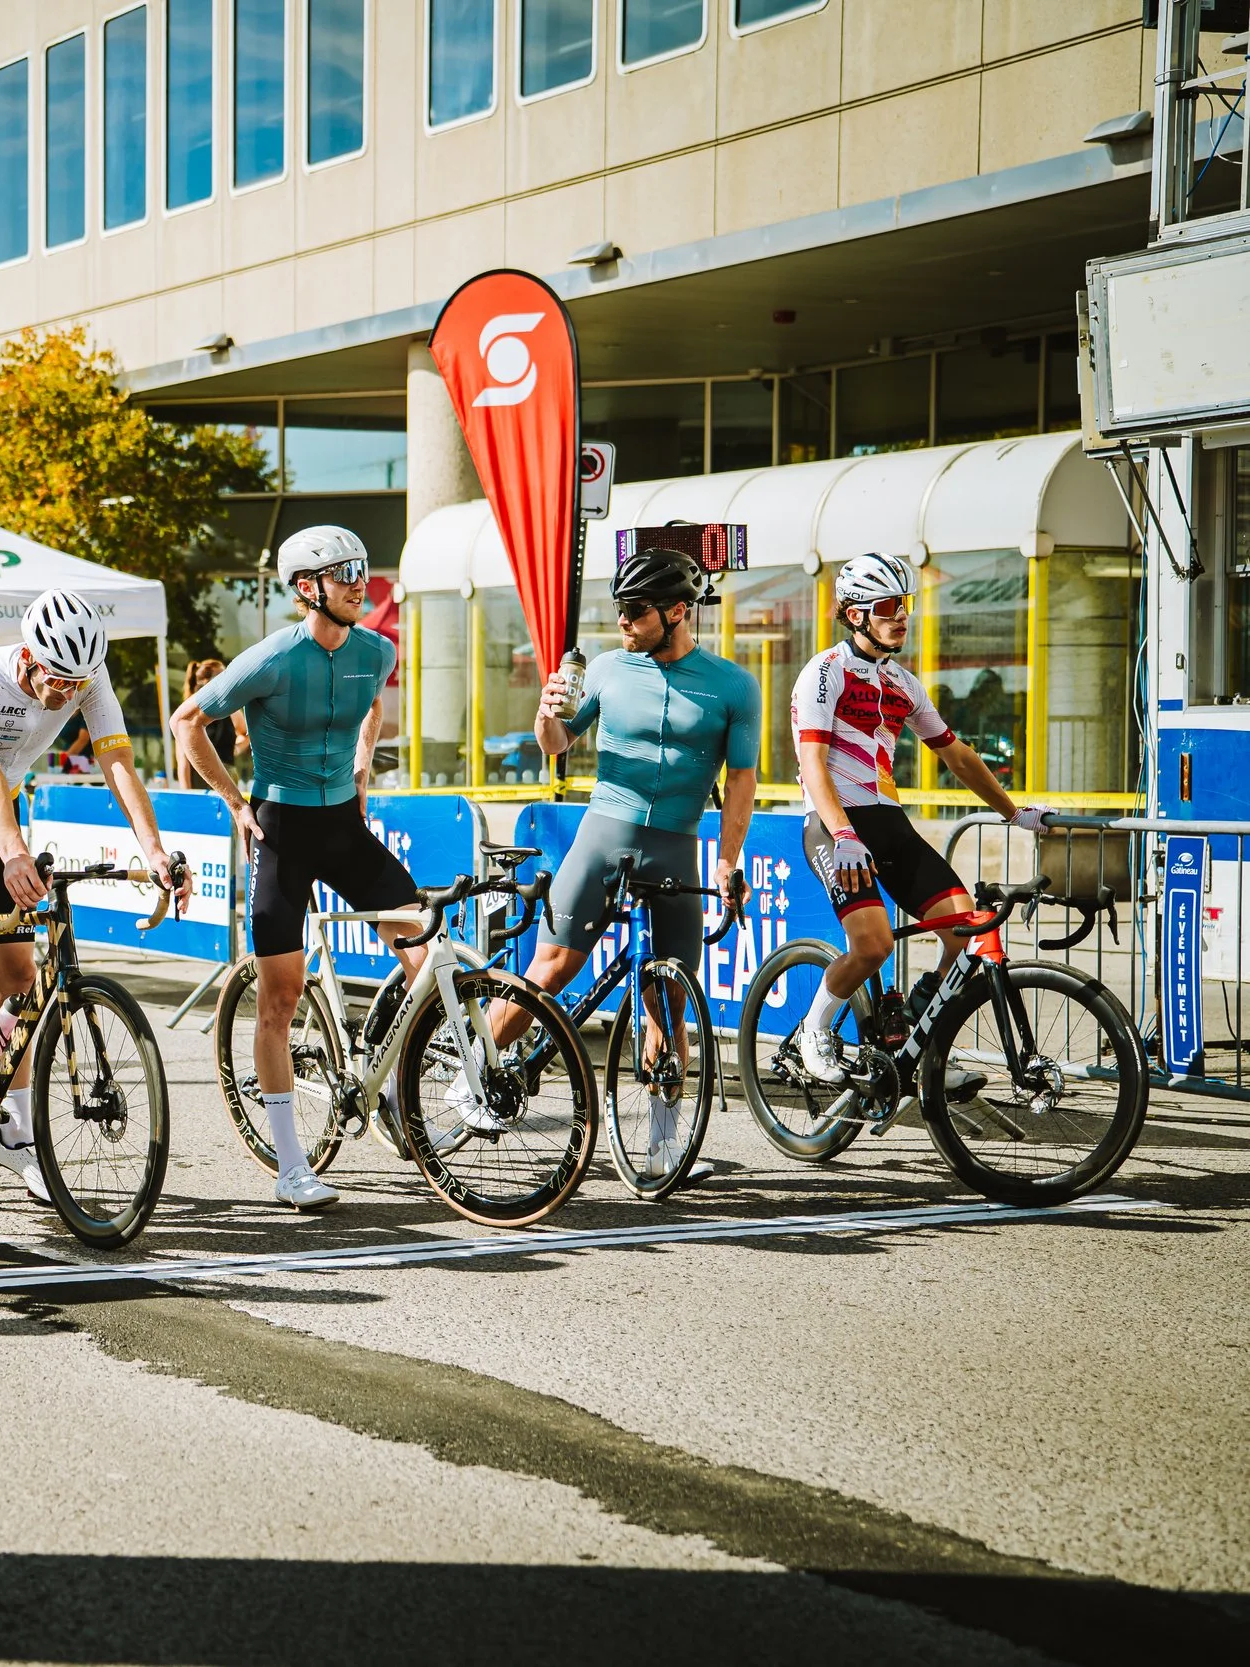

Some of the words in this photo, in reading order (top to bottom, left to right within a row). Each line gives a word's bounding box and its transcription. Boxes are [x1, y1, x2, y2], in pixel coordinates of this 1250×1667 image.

[702, 524, 726, 570] 0
[0, 706, 27, 716] LRCC
[100, 736, 131, 749] LRCC
[753, 856, 773, 891] DE
[1171, 865, 1198, 875] Gatineau
[760, 892, 773, 915] OF
[1178, 902, 1188, 1043] ÉVÉNEMENT
[897, 936, 985, 1059] TREK
[371, 993, 414, 1074] MAGNAN
[452, 1020, 468, 1062] MAGNAN
